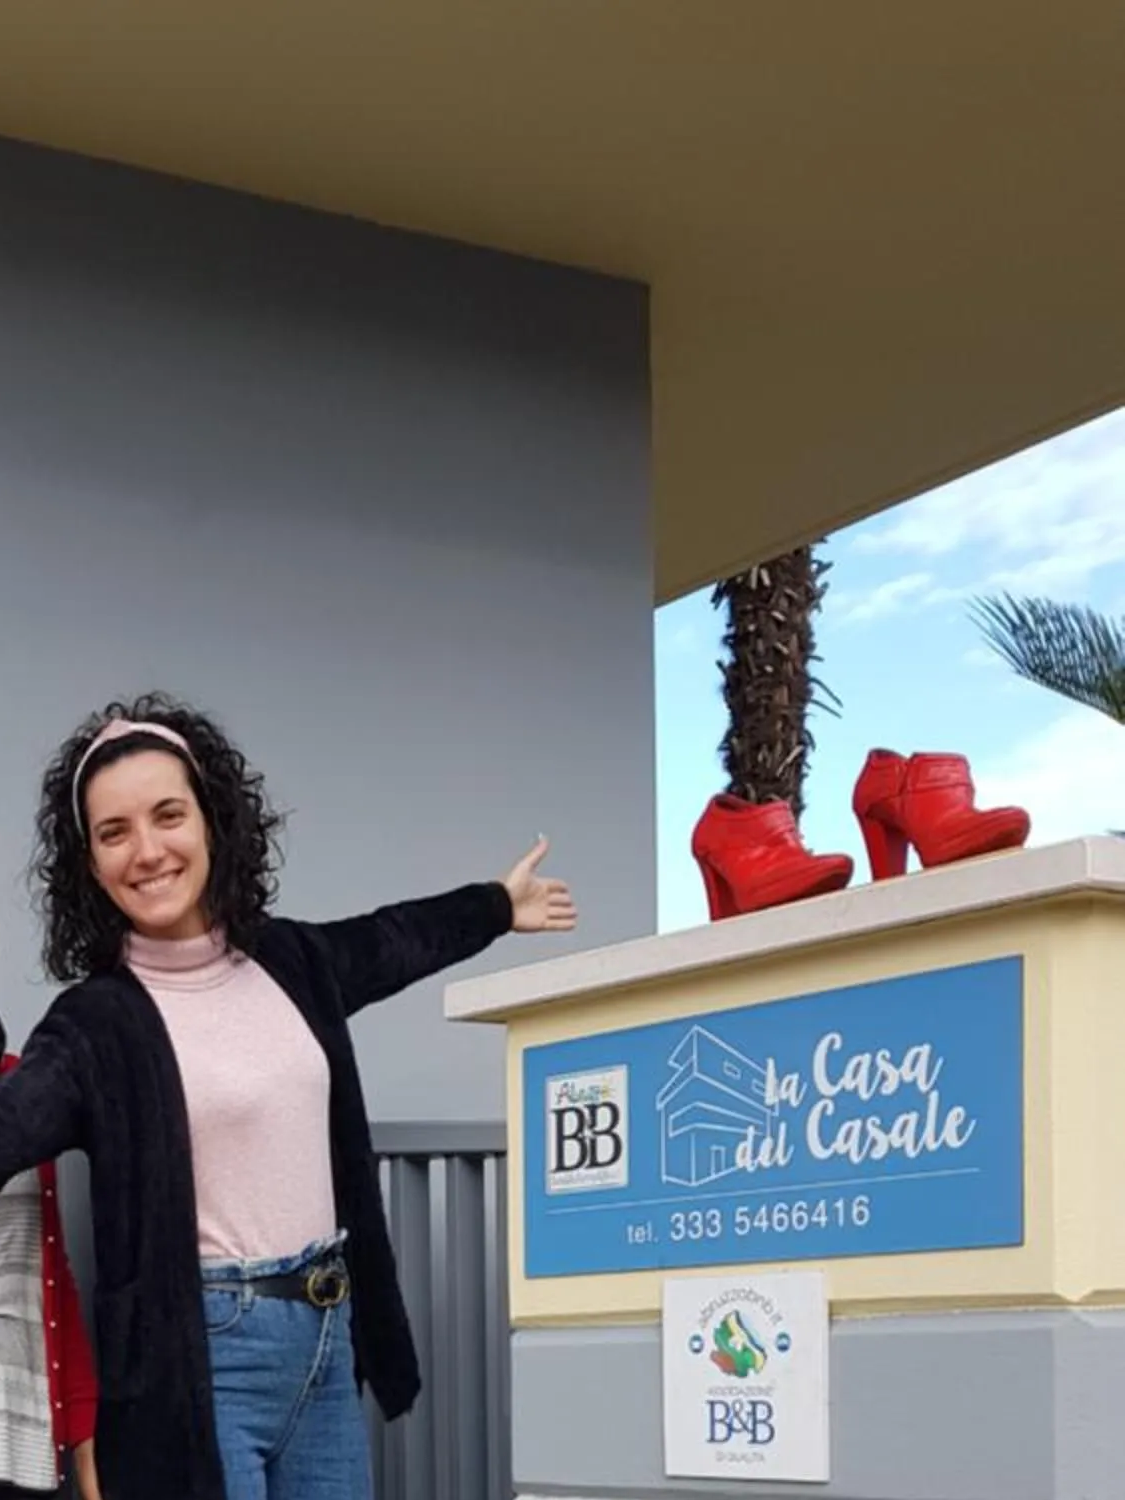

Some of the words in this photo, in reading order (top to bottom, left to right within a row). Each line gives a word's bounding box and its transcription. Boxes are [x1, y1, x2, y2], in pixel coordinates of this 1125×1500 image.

[813, 1032, 944, 1100] Casa
[735, 1121, 794, 1172] del
[806, 1089, 976, 1164] Casale
[627, 1222, 659, 1244] tel.
[670, 1209, 722, 1240] 333
[734, 1195, 871, 1235] 5466416
[706, 1399, 775, 1445] B&B
